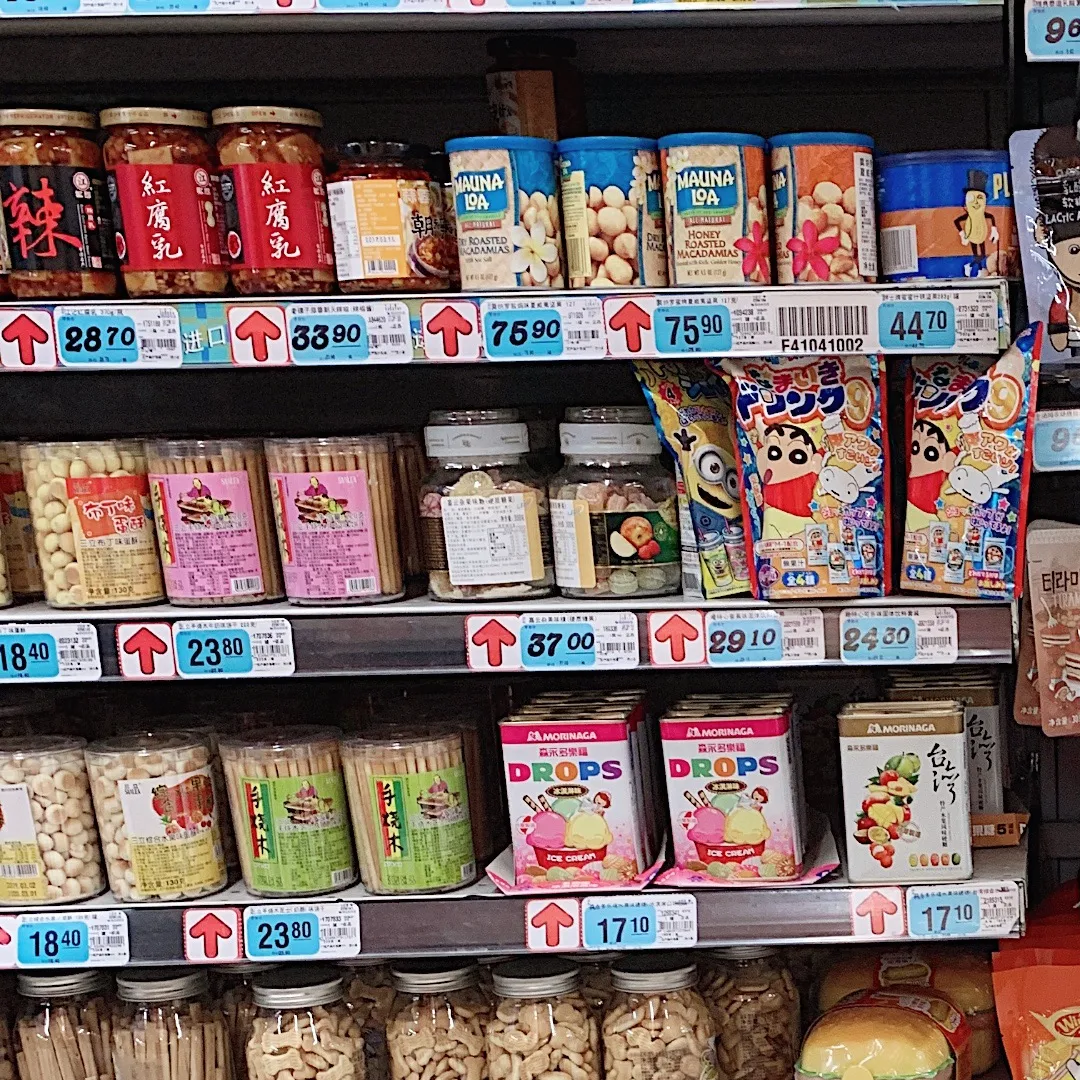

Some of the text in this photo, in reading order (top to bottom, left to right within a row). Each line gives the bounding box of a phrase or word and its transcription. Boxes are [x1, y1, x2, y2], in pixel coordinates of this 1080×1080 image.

[454, 173, 505, 195] MAUNA
[677, 168, 735, 188] MAUNA
[464, 193, 490, 211] LOA
[691, 187, 720, 206] LOA
[4, 177, 84, 259] 辣
[141, 170, 183, 260] 紅腐乳
[260, 169, 301, 259] 紅腐乳
[1044, 211, 1075, 225] LACTIC
[468, 236, 508, 246] ROASTED
[685, 239, 726, 249] ROASTED
[688, 230, 721, 240] HONEY
[677, 249, 739, 259] MACADAMIAS
[291, 322, 362, 351] 3390
[491, 319, 561, 347] 7590
[665, 313, 724, 346] 7590
[890, 310, 948, 341] 4470
[65, 325, 135, 353] 2870
[182, 324, 227, 354] 进口
[781, 338, 864, 352] F41041002
[83, 496, 136, 521] 布丁味
[113, 517, 146, 533] 蛋酥
[188, 636, 244, 667] 2380
[527, 631, 595, 658] 3700
[709, 628, 776, 655] 2910
[543, 731, 597, 741] MORINAGA
[702, 727, 754, 737] MORINAGA
[882, 723, 936, 734] MORINAGA
[508, 760, 623, 783] DROPS
[669, 755, 779, 778] DROPS
[547, 852, 597, 862] ICE CREAM
[707, 848, 755, 857] ICE CREAM
[922, 904, 973, 932] 1710
[258, 921, 312, 949] 2380
[598, 916, 650, 944] 1710
[29, 929, 81, 957] 1840
